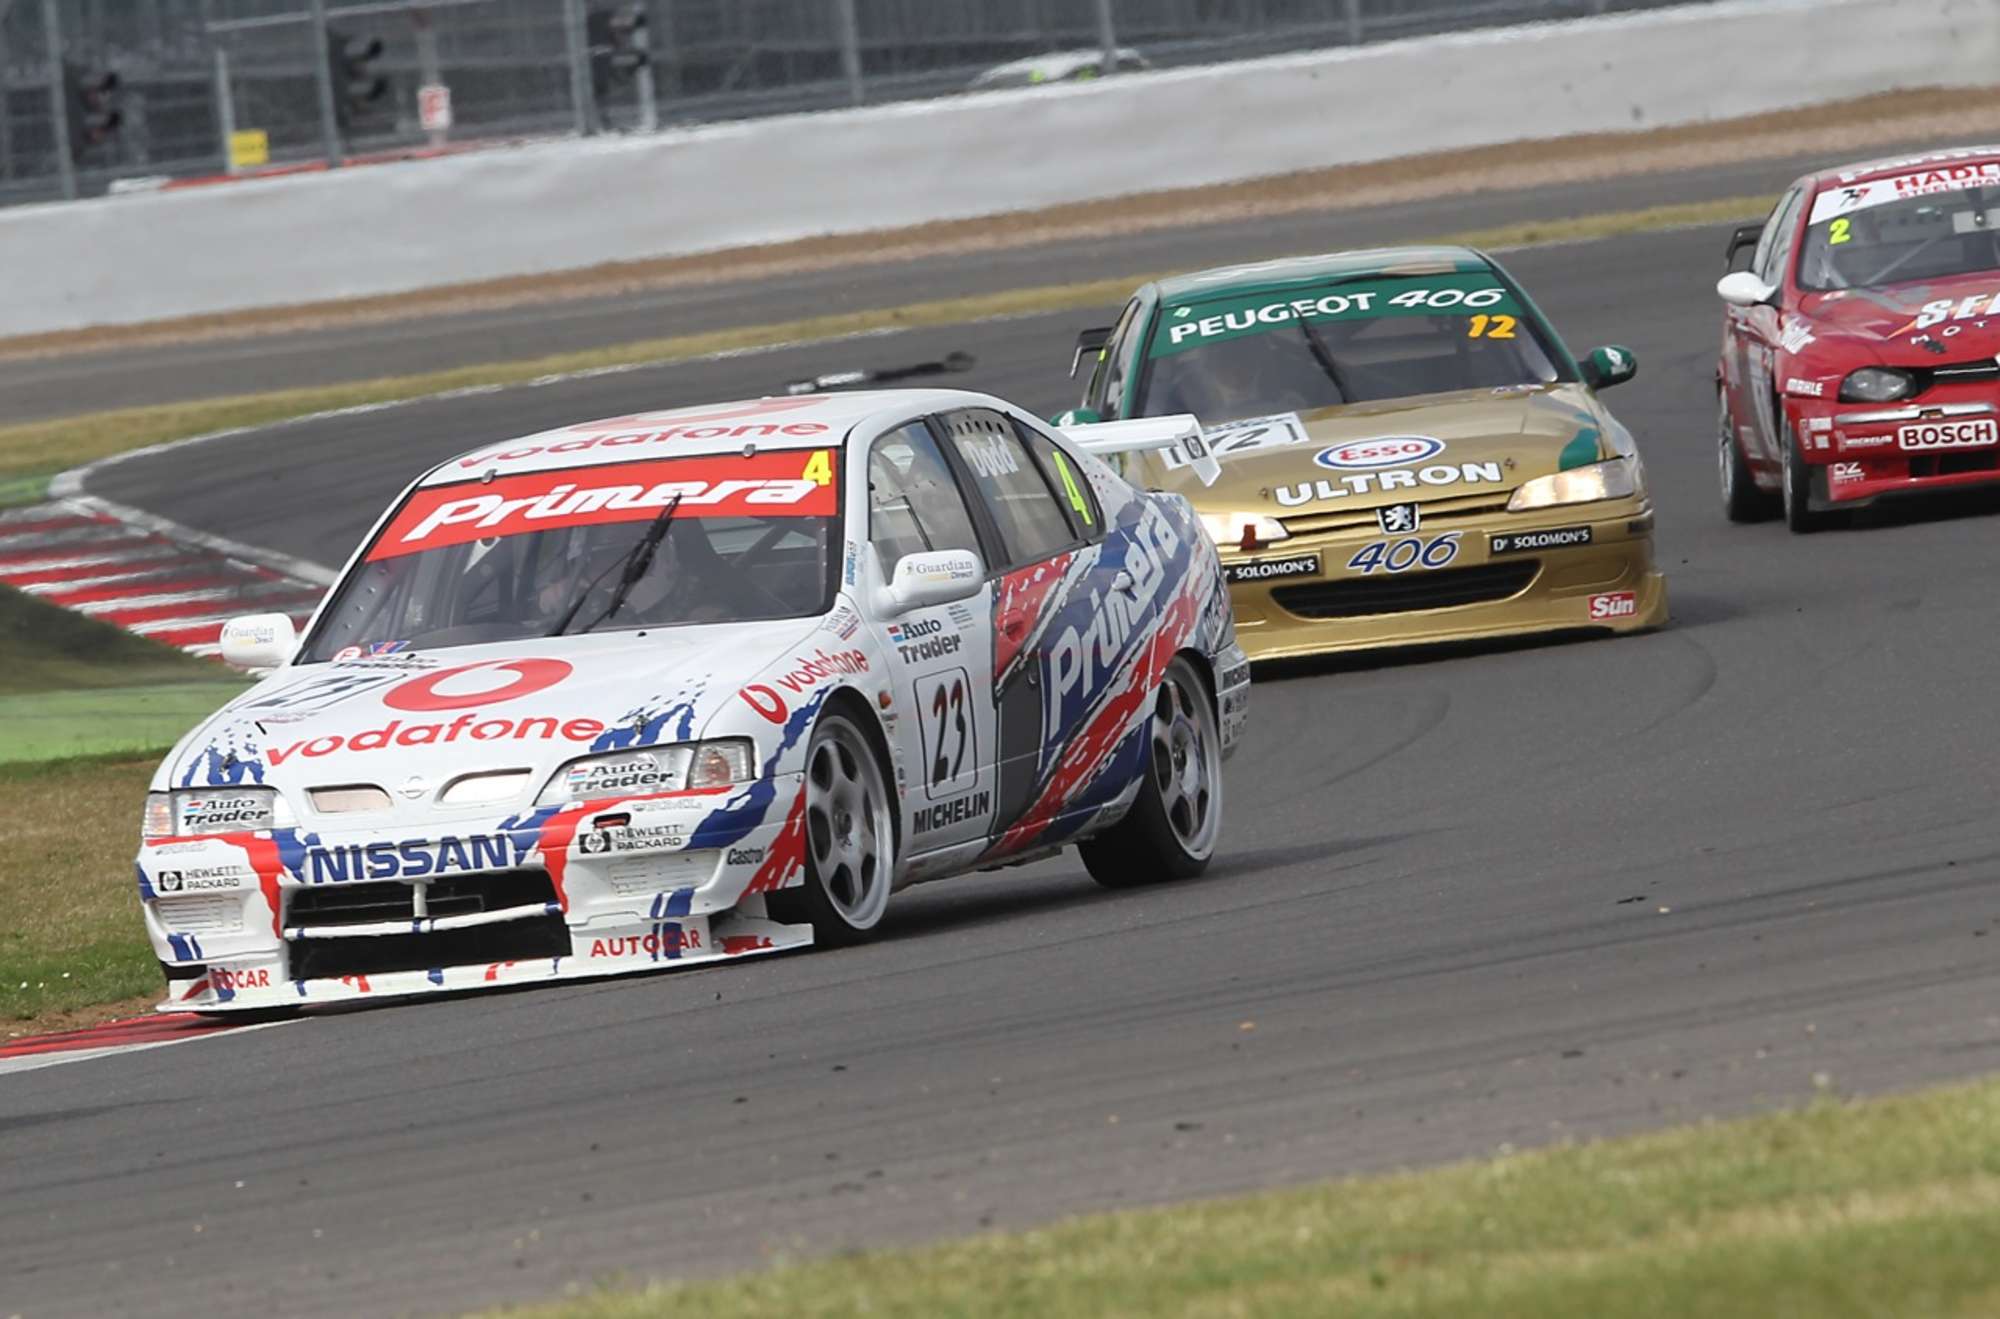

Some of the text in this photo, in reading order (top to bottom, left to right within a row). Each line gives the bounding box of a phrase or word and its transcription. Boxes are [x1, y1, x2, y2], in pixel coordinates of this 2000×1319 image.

[1829, 217, 1851, 245] 2
[1169, 288, 1507, 344] PEUGEOT 406
[1468, 314, 1516, 338] 12
[458, 421, 830, 468] vodafone
[1903, 423, 1992, 447] BOSCH
[801, 450, 833, 486] 4
[963, 434, 1019, 478] Dodd
[1052, 451, 1092, 525] 4
[1273, 460, 1503, 507] ULTRON
[401, 478, 818, 543] Primera
[1347, 531, 1463, 575] 406
[1514, 529, 1590, 549] SOLOMON'S
[916, 560, 973, 574] Guardian
[950, 571, 974, 579] Direct
[1236, 559, 1315, 579] SOLOMON'S
[902, 617, 942, 641] Auto
[1048, 500, 1180, 741] Primera
[898, 634, 961, 664] Trader
[777, 648, 870, 693] vodafone
[265, 712, 605, 767] vodafone
[932, 677, 967, 788] 23
[569, 771, 674, 793] Trader
[587, 762, 655, 778] Auto
[183, 809, 269, 826] Trader
[203, 799, 256, 811] Auto
[913, 790, 990, 835] MICHELIN
[616, 824, 680, 839] HEWLETT
[617, 836, 683, 850] PACKARD
[186, 866, 238, 879] HEWLETT
[311, 833, 510, 884] NISSAN
[187, 878, 240, 890] PACKARD
[591, 929, 702, 957] AUTOCAR
